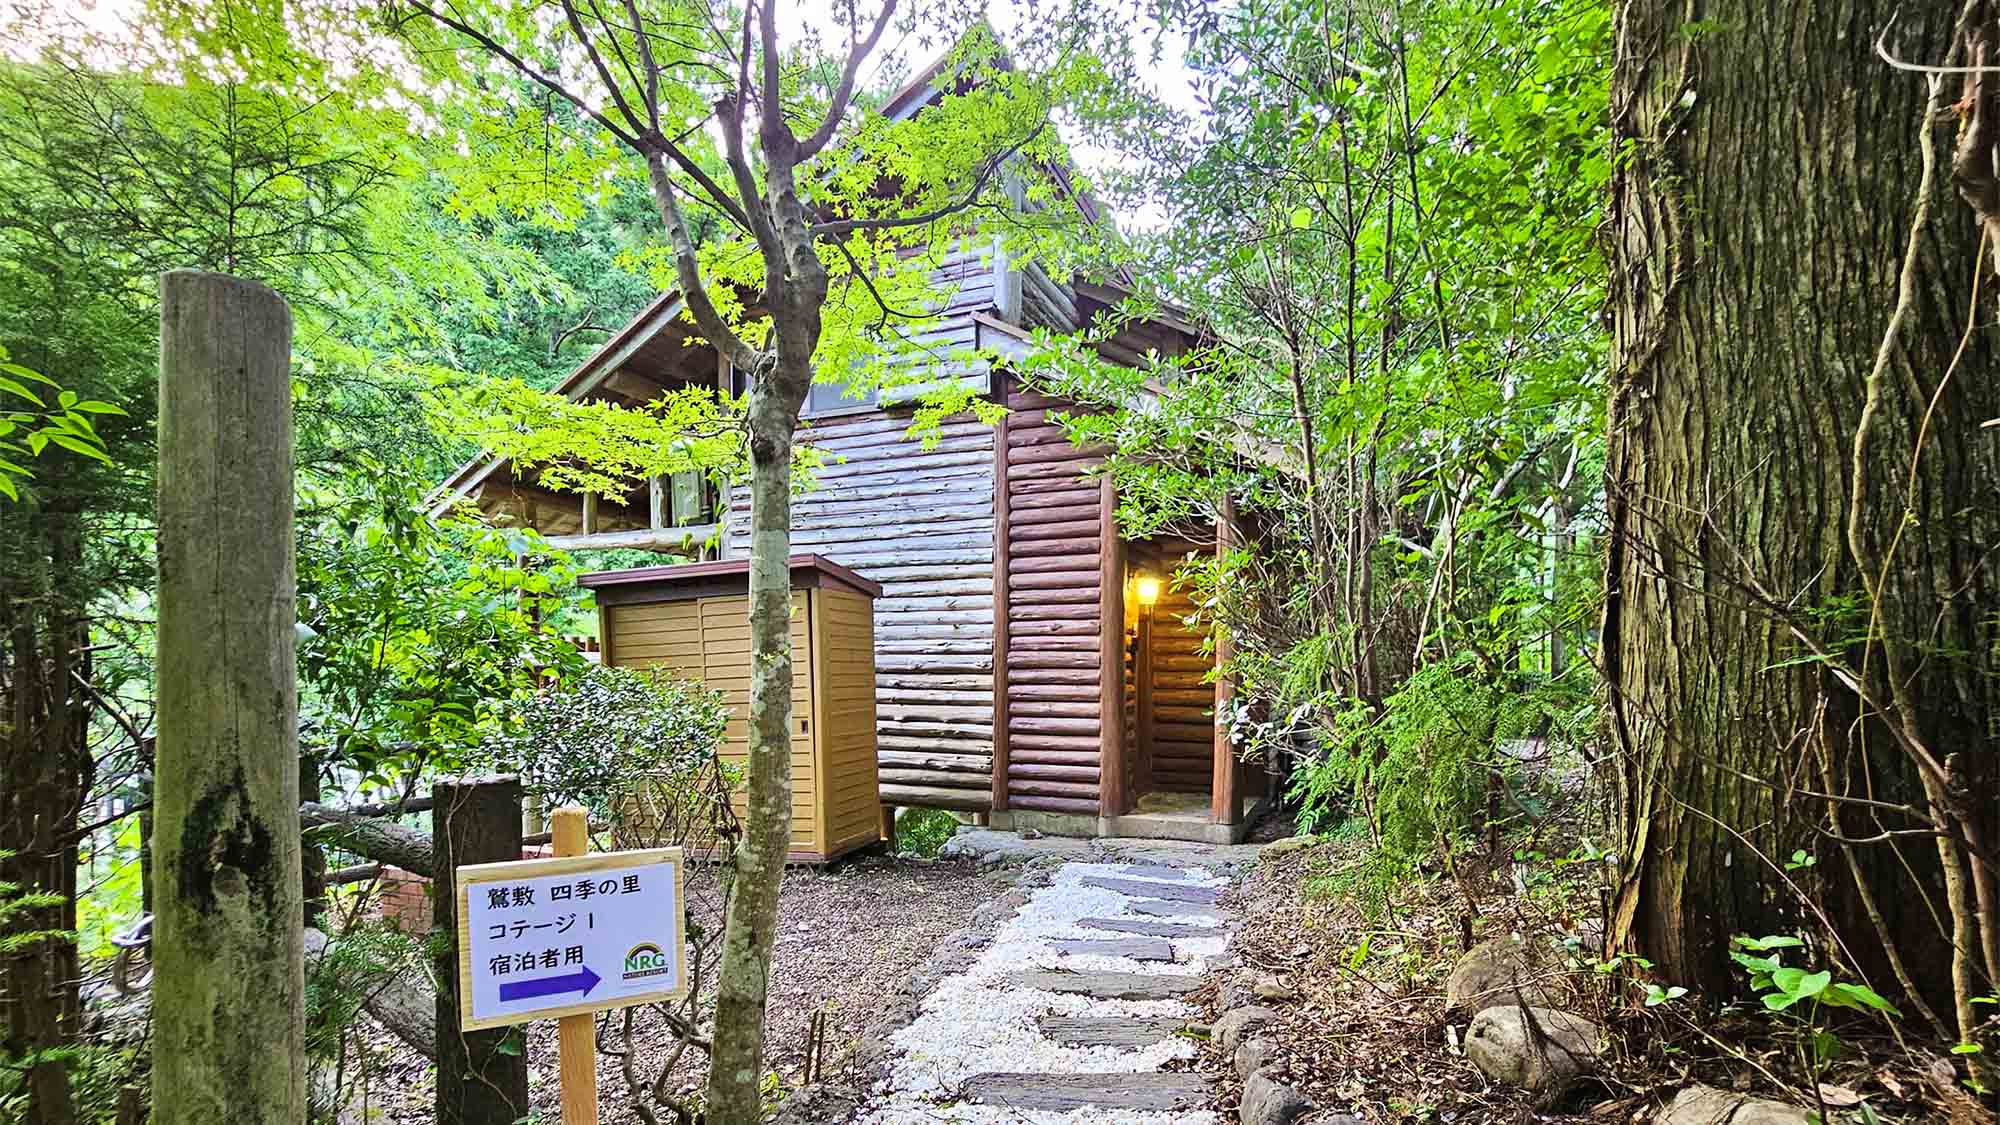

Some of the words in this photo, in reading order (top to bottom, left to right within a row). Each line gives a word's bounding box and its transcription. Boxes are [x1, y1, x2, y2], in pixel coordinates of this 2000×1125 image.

[487, 886, 535, 910] 鷲敷
[550, 874, 641, 901] 四季の里
[489, 912, 576, 940] コテージ
[489, 945, 584, 976] 宿泊者用
[624, 953, 665, 972] NRG
